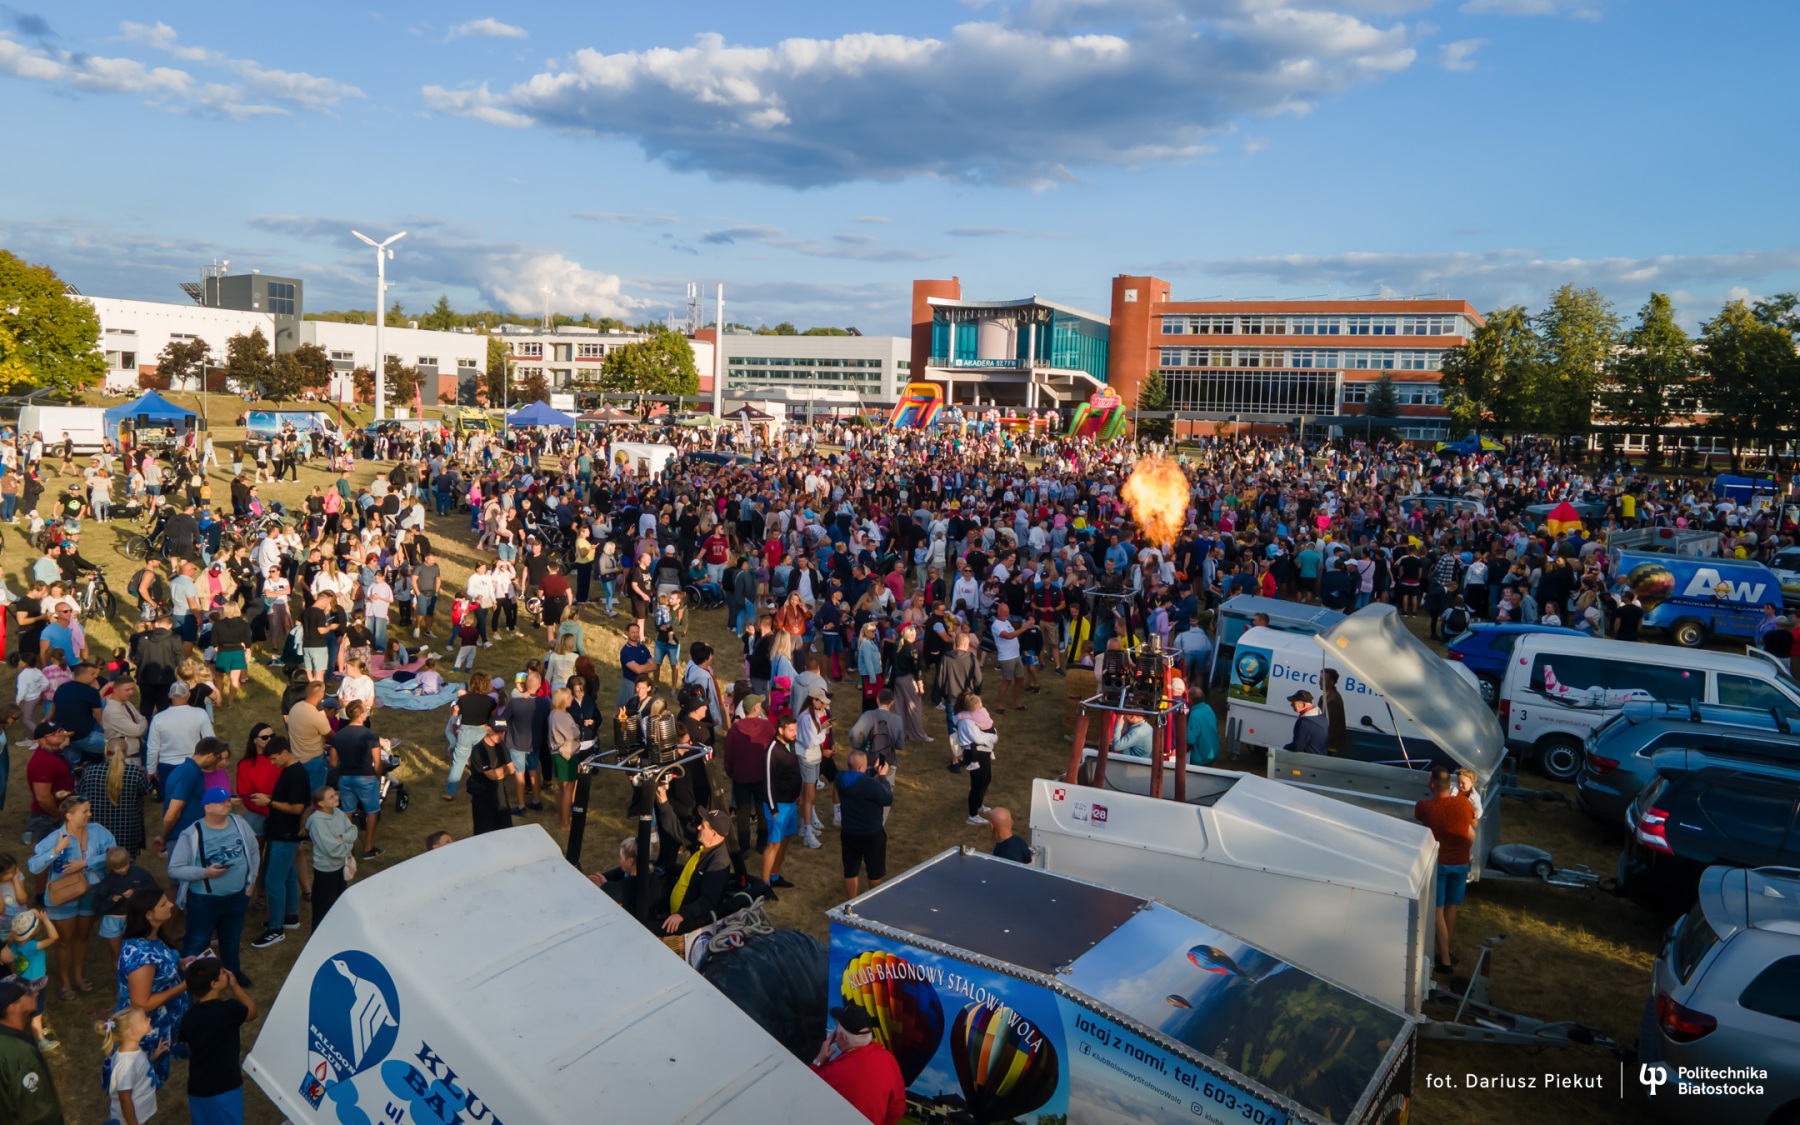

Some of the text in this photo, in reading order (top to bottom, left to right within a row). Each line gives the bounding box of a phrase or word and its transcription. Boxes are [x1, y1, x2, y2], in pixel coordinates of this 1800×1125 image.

[1760, 500, 1770, 508] 24
[1272, 664, 1318, 685] Dierc
[1520, 710, 1527, 720] 3
[847, 963, 1043, 1053] KLUB BALONOWY STALOWA WOLA
[310, 1024, 357, 1075] BALLOON
[314, 1041, 343, 1072] CLUB
[1075, 1014, 1112, 1046] lataj
[1114, 1036, 1121, 1050] z
[1124, 1043, 1168, 1076] nami,
[1174, 1066, 1200, 1092] tel.
[414, 1040, 504, 1125] KLU
